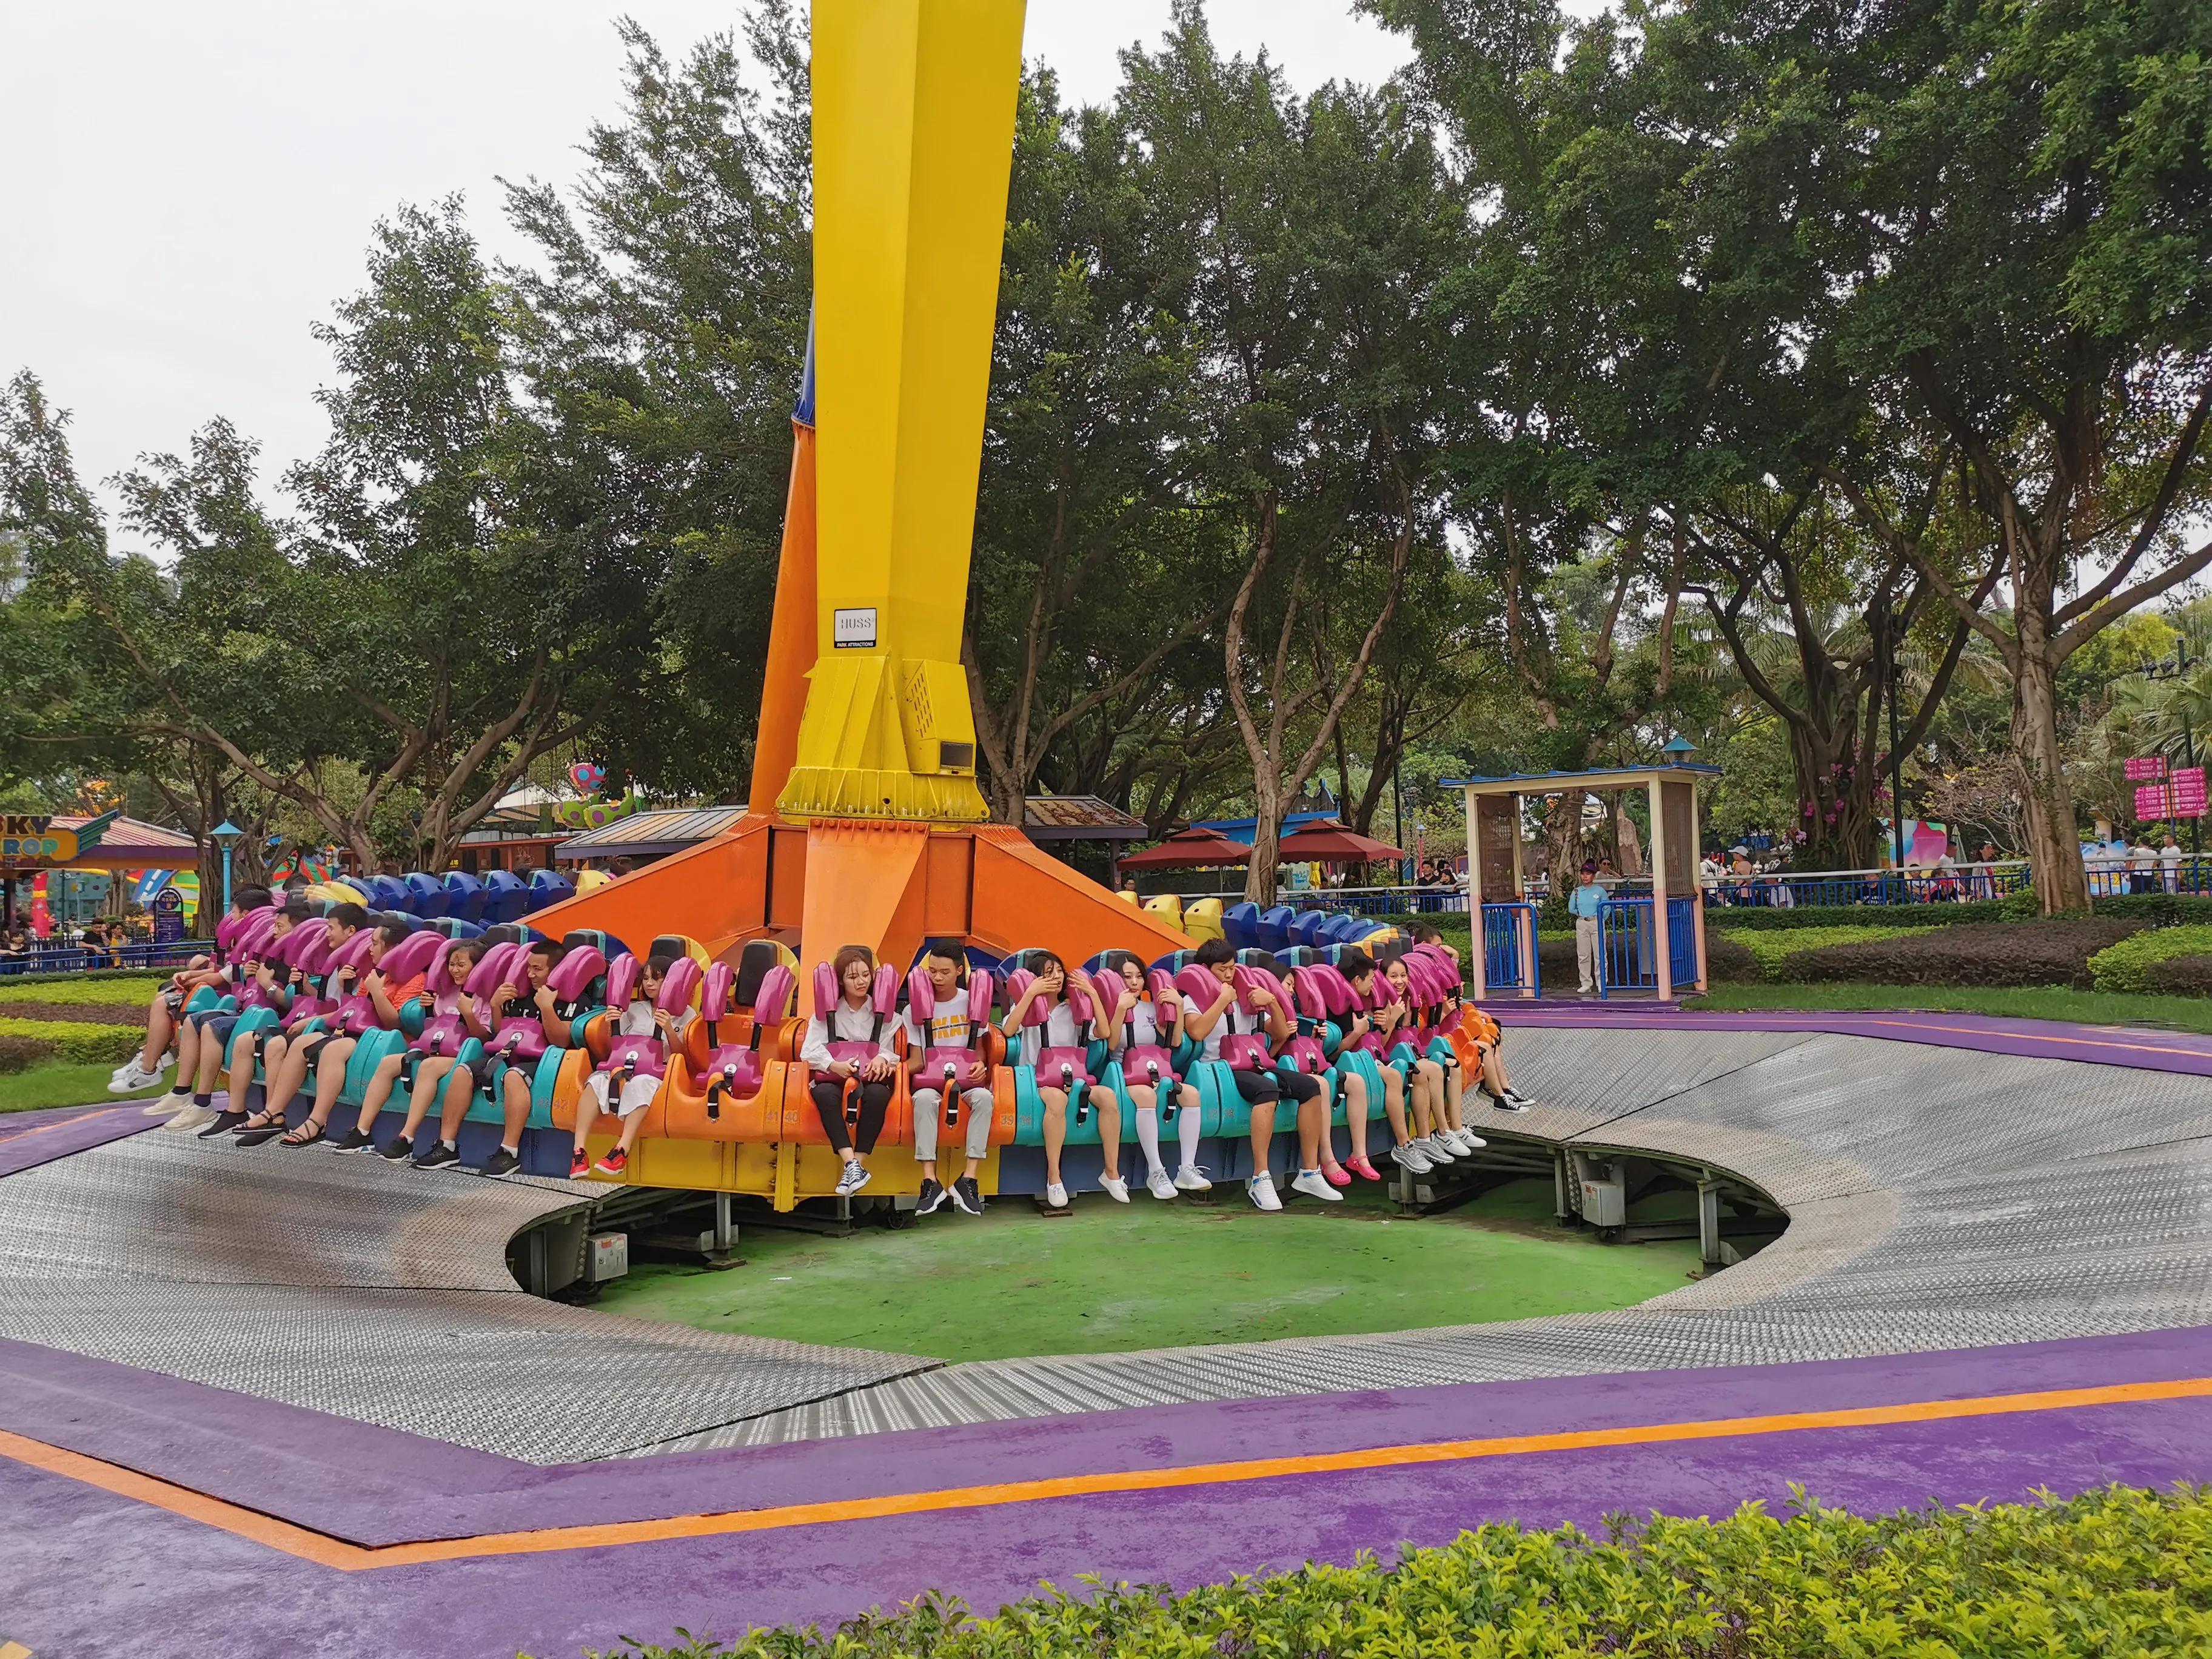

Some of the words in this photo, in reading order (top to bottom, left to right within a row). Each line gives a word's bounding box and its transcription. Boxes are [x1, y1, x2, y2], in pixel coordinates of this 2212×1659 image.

[841, 617, 871, 629] HUSS
[0, 815, 52, 834] KY
[0, 838, 59, 855] ROP
[1000, 1114, 1014, 1125] 39
